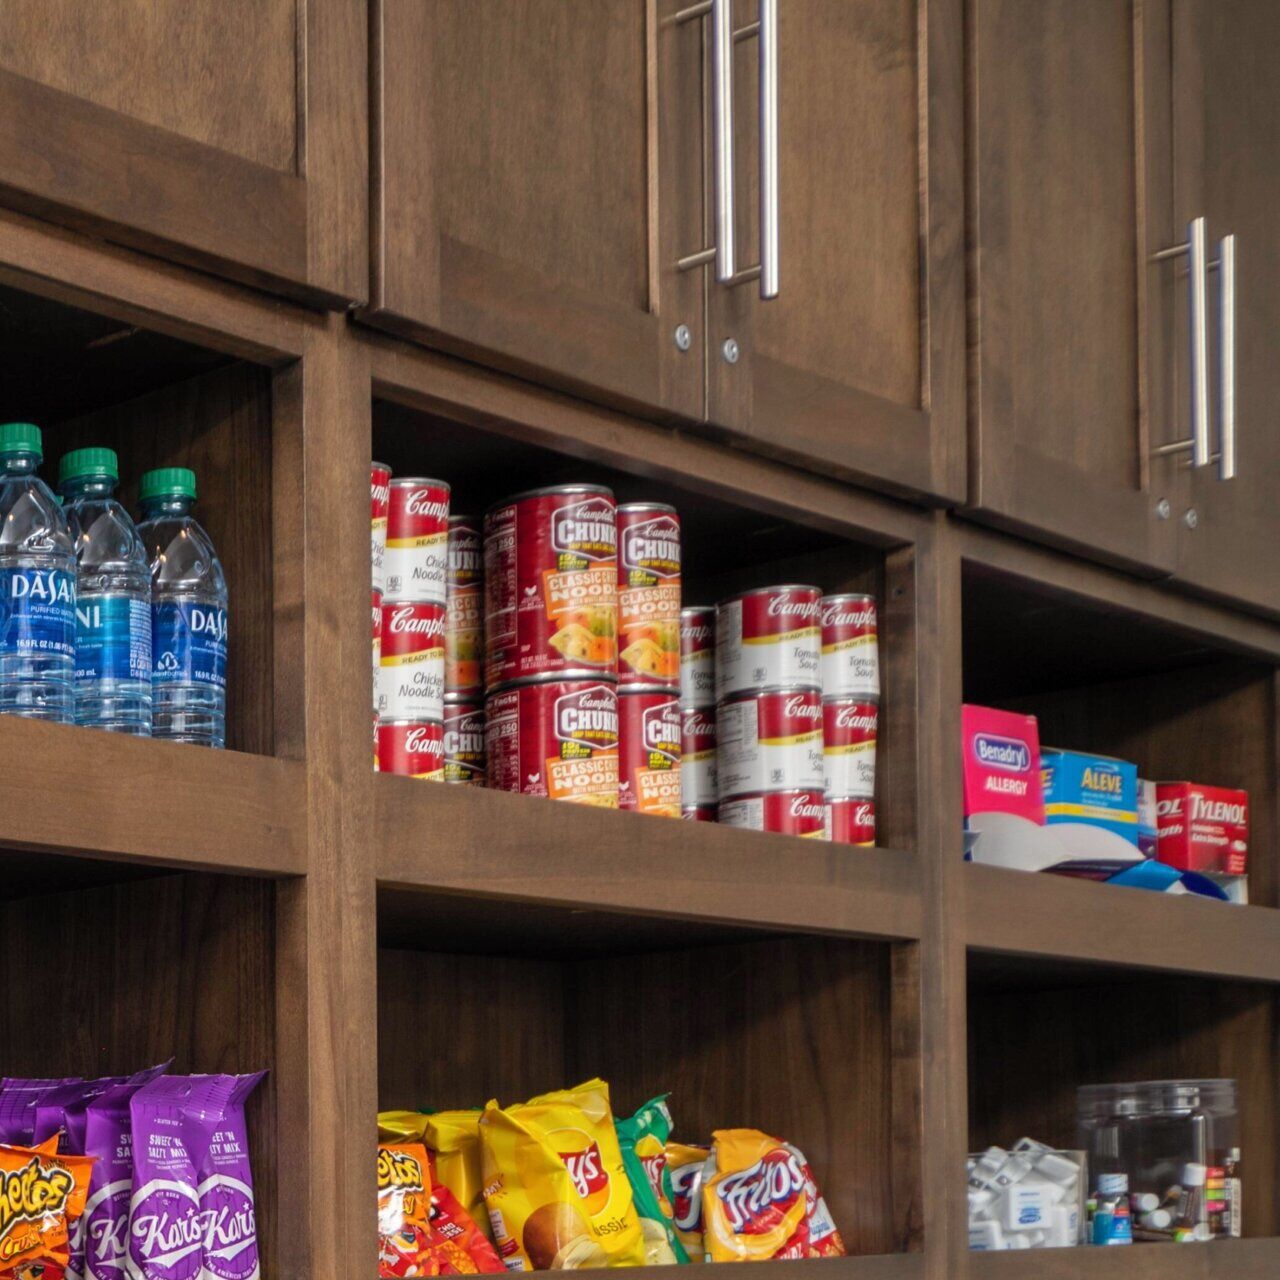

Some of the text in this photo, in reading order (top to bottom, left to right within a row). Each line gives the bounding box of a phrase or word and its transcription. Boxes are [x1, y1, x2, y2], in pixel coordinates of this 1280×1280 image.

[416, 536, 438, 547] READY
[412, 566, 443, 583] Noodle
[548, 570, 601, 590] CLASSIC
[31, 605, 61, 616] PURIFIED
[16, 639, 39, 649] 16.9 FL
[402, 654, 429, 664] READY
[798, 658, 818, 671] Soup
[854, 667, 875, 679] Soup
[398, 684, 434, 700] Noodle
[500, 723, 517, 735] 250
[979, 739, 1026, 768] Benadryl
[552, 759, 606, 778] CLASSIC
[985, 775, 1028, 797] ALLERGY
[1081, 766, 1123, 794] ALEVE
[1190, 790, 1246, 825] TYLENOL
[149, 1133, 173, 1147] SWEET
[224, 1142, 241, 1154] MIX
[717, 1155, 810, 1232] Fritos
[132, 1206, 203, 1258] Kar's
